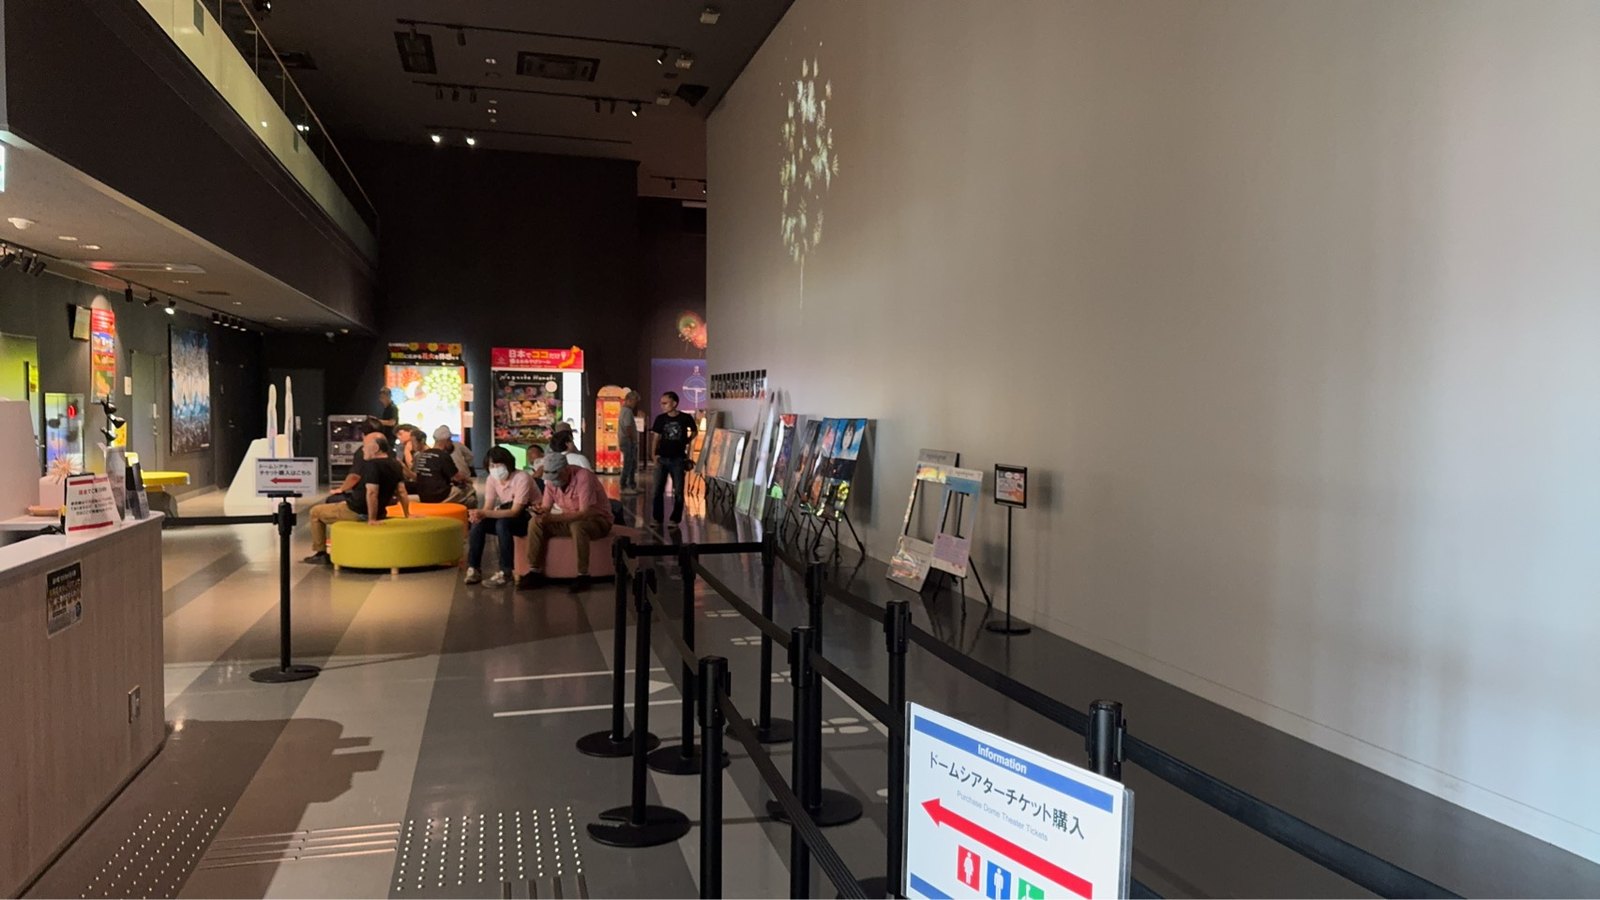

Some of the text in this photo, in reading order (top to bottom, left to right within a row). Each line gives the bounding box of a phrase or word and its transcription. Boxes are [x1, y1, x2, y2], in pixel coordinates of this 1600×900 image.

[977, 743, 1028, 775] Information
[929, 751, 1085, 840] ドームシアターチケット購入
[956, 789, 1048, 842] Purchase Dome Theater Tickets
